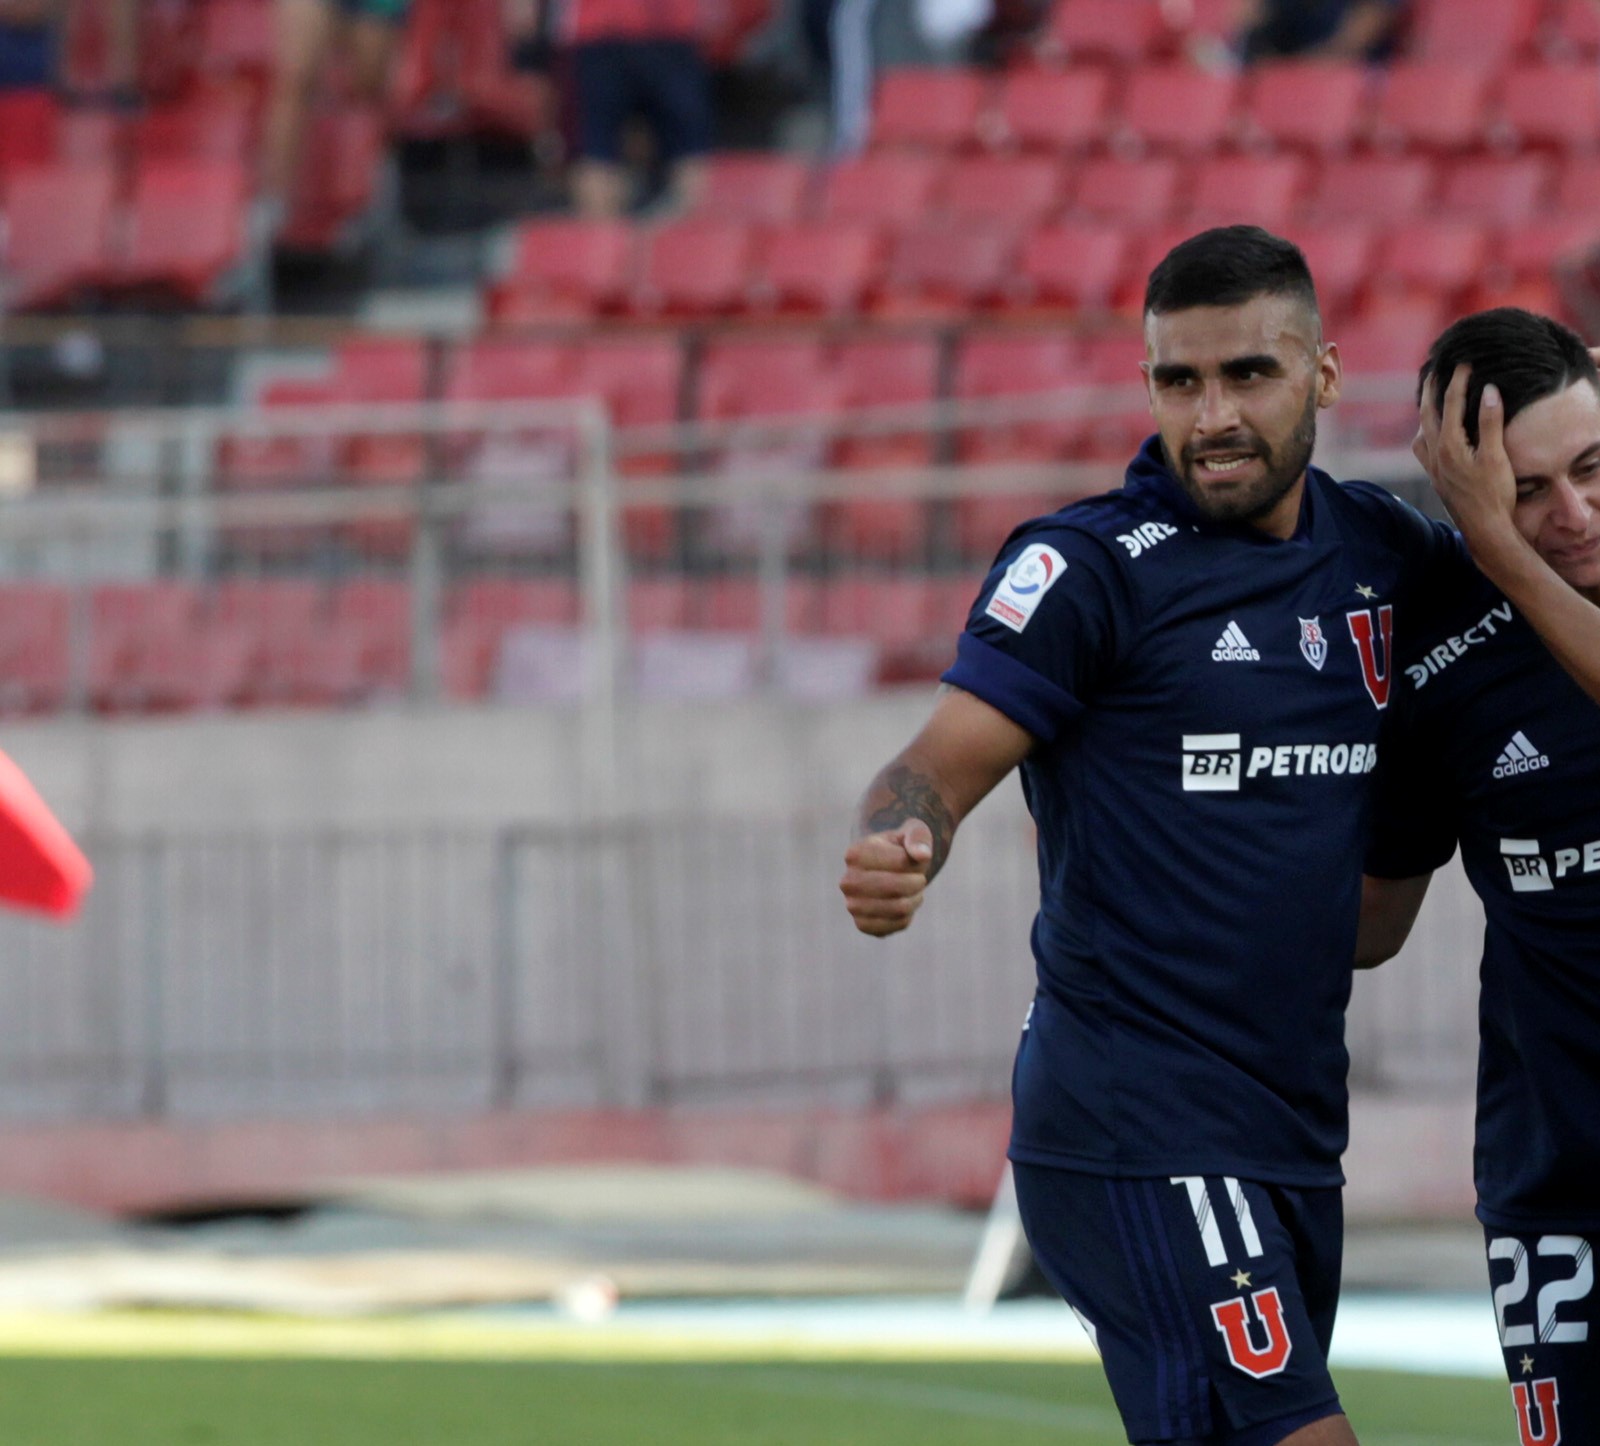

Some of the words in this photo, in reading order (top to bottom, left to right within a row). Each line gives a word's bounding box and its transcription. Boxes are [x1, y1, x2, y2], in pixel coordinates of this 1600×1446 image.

[1116, 521, 1178, 558] DIRE
[1212, 646, 1260, 662] adidas
[1346, 604, 1392, 711] U
[1404, 601, 1513, 690] DIRECTV
[1190, 754, 1234, 776] BR
[1493, 754, 1550, 779] adidas
[1511, 857, 1542, 877] BR
[1169, 1176, 1264, 1267] 11
[1489, 1235, 1594, 1347] 22
[1210, 1286, 1293, 1379] U
